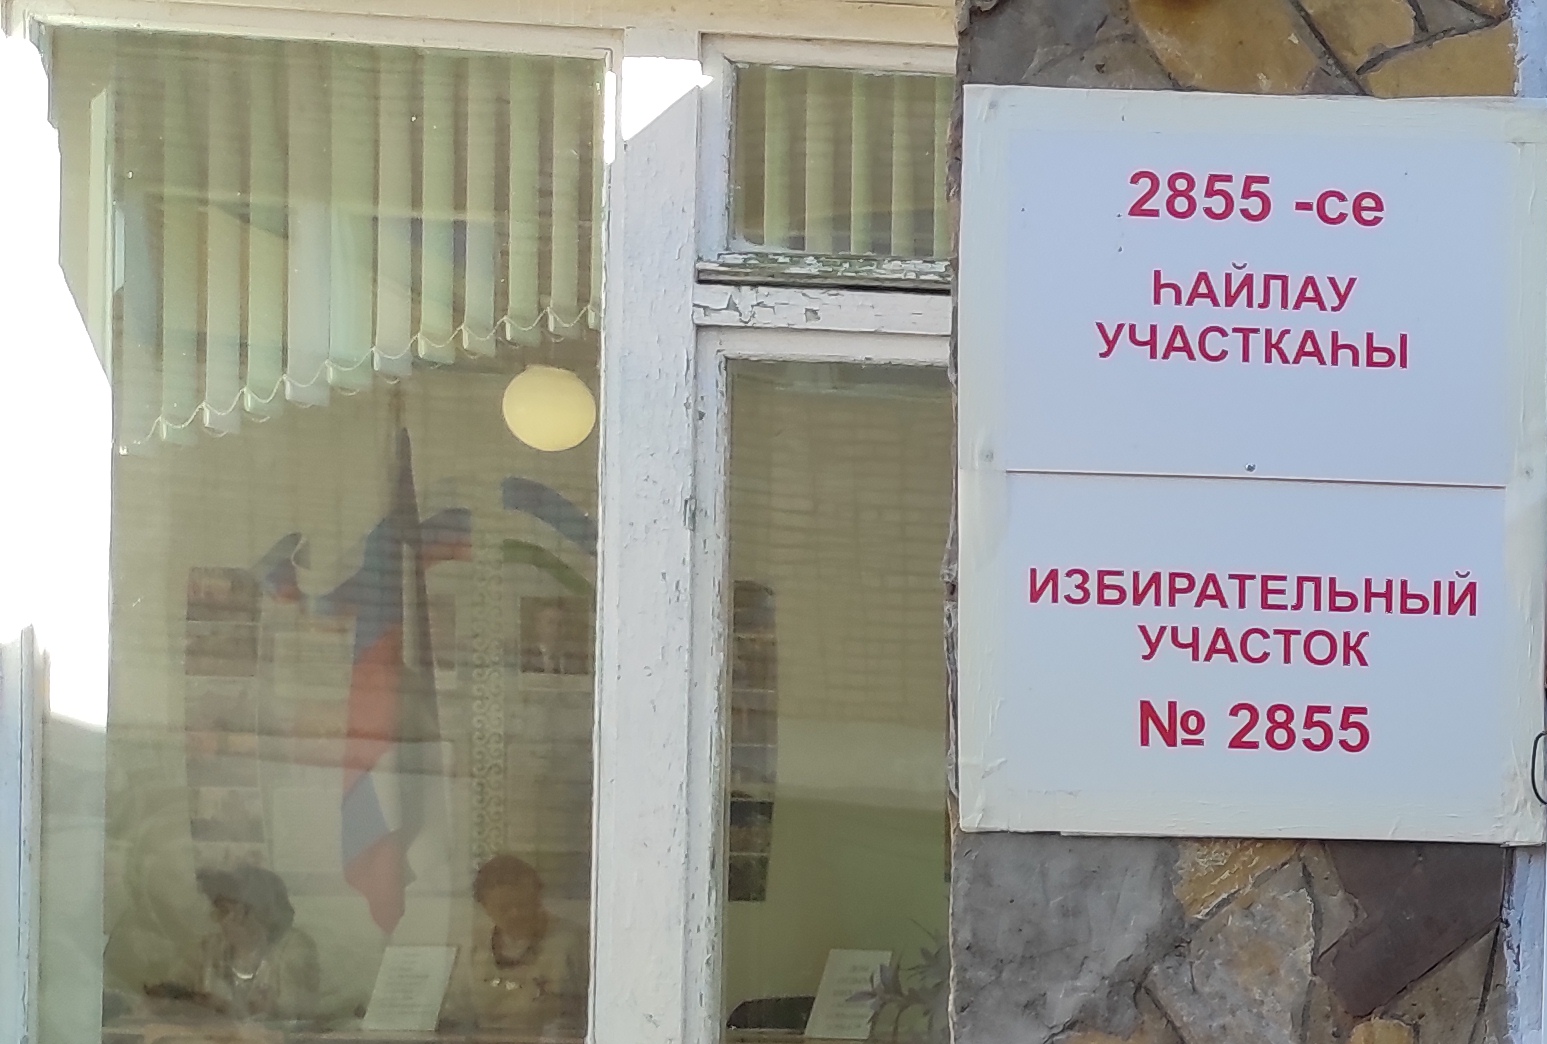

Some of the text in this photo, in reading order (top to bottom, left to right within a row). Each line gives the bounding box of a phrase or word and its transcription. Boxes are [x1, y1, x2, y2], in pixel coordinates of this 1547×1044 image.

[1128, 171, 1384, 226] 2855 -се
[1154, 263, 1357, 312] ҺАЙЛАУ
[1096, 322, 1407, 368] УЧАСТКАҺЫ
[1030, 568, 1476, 616] ИЗБИРАТЕЛЬНЫЙ
[1138, 625, 1369, 666] УЧАСТОК
[1140, 700, 1369, 752] № 2855
